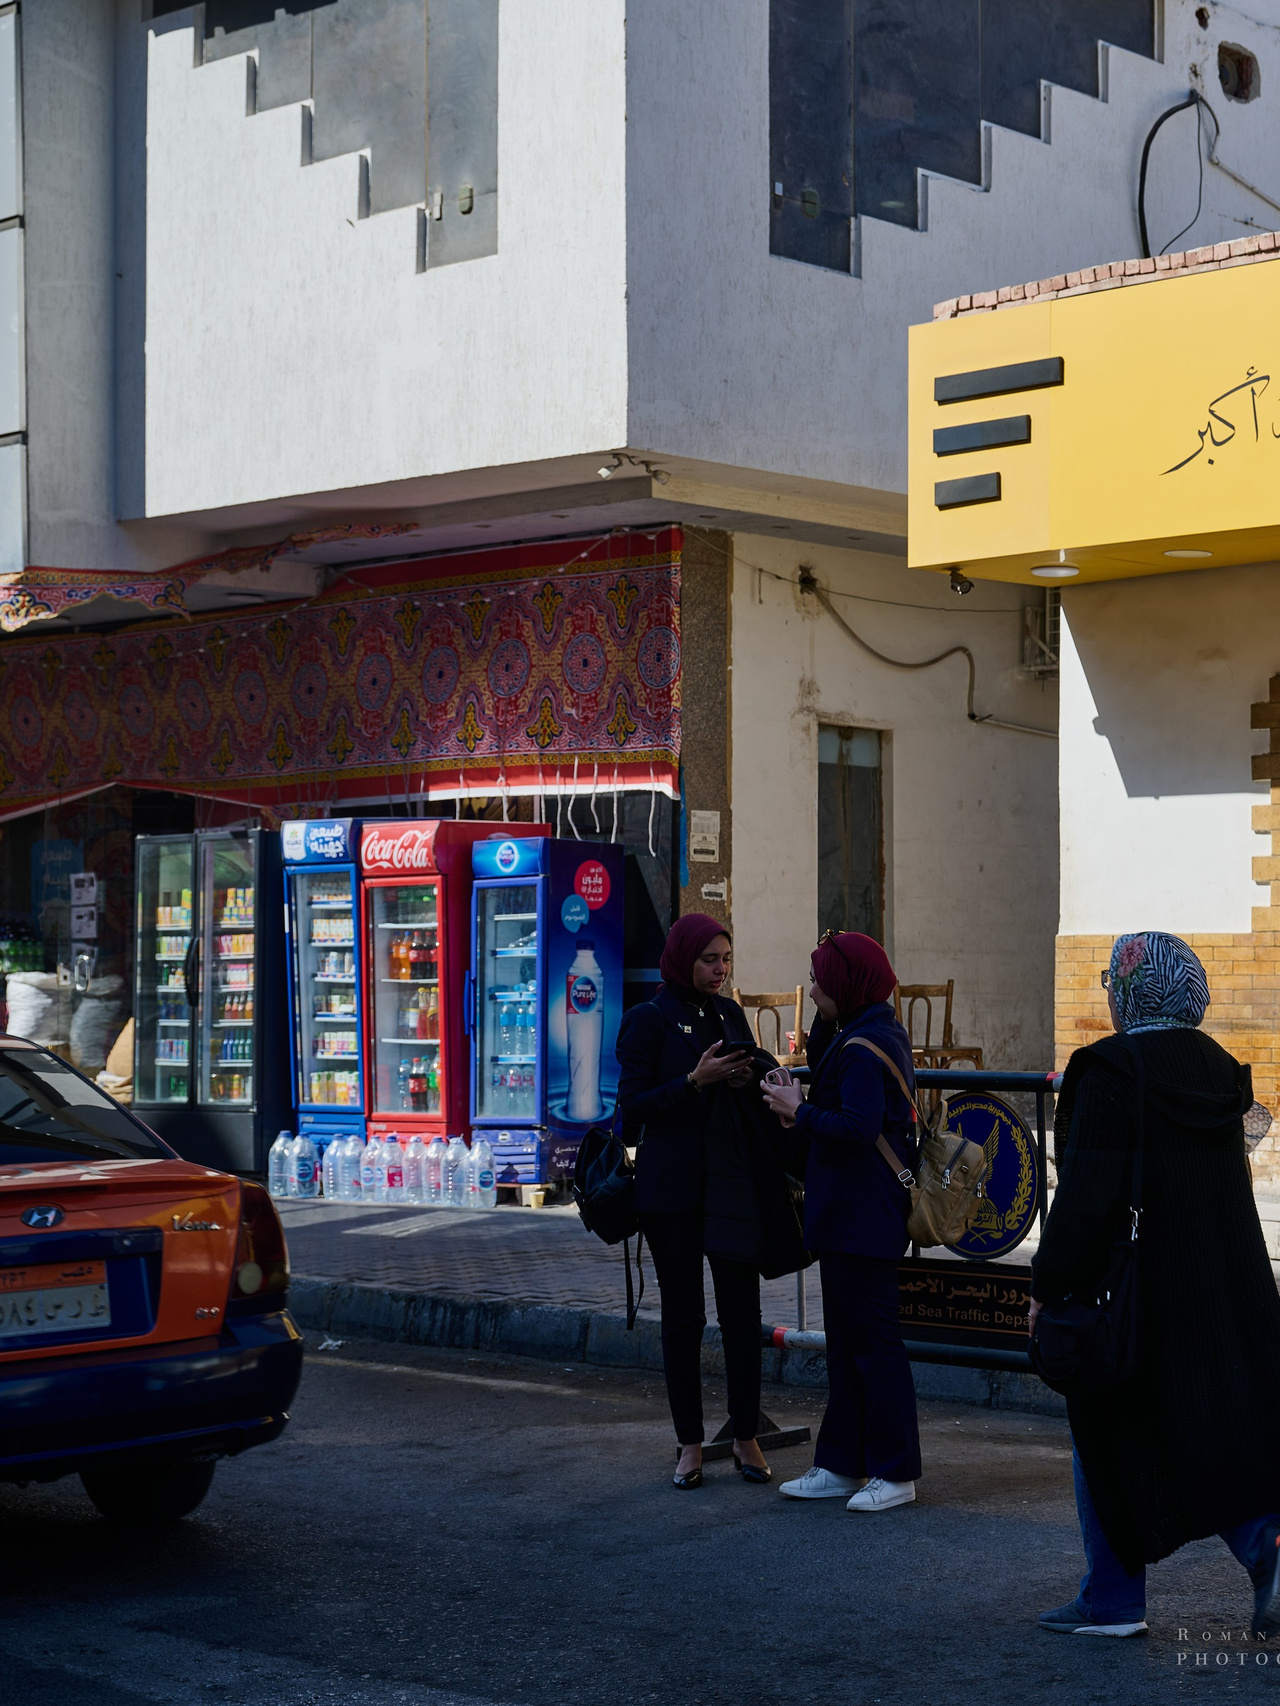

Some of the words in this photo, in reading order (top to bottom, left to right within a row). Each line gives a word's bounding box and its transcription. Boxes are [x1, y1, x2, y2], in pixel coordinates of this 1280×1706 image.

[1159, 365, 1271, 477] أكبر
[361, 829, 434, 869] Coca-Cola
[171, 1211, 222, 1232] Verna
[898, 1273, 945, 1294] الأحم
[945, 1281, 998, 1304] البحر
[917, 1303, 942, 1318] Sea
[946, 1305, 990, 1323] Traffic
[994, 1310, 1030, 1328] Depa
